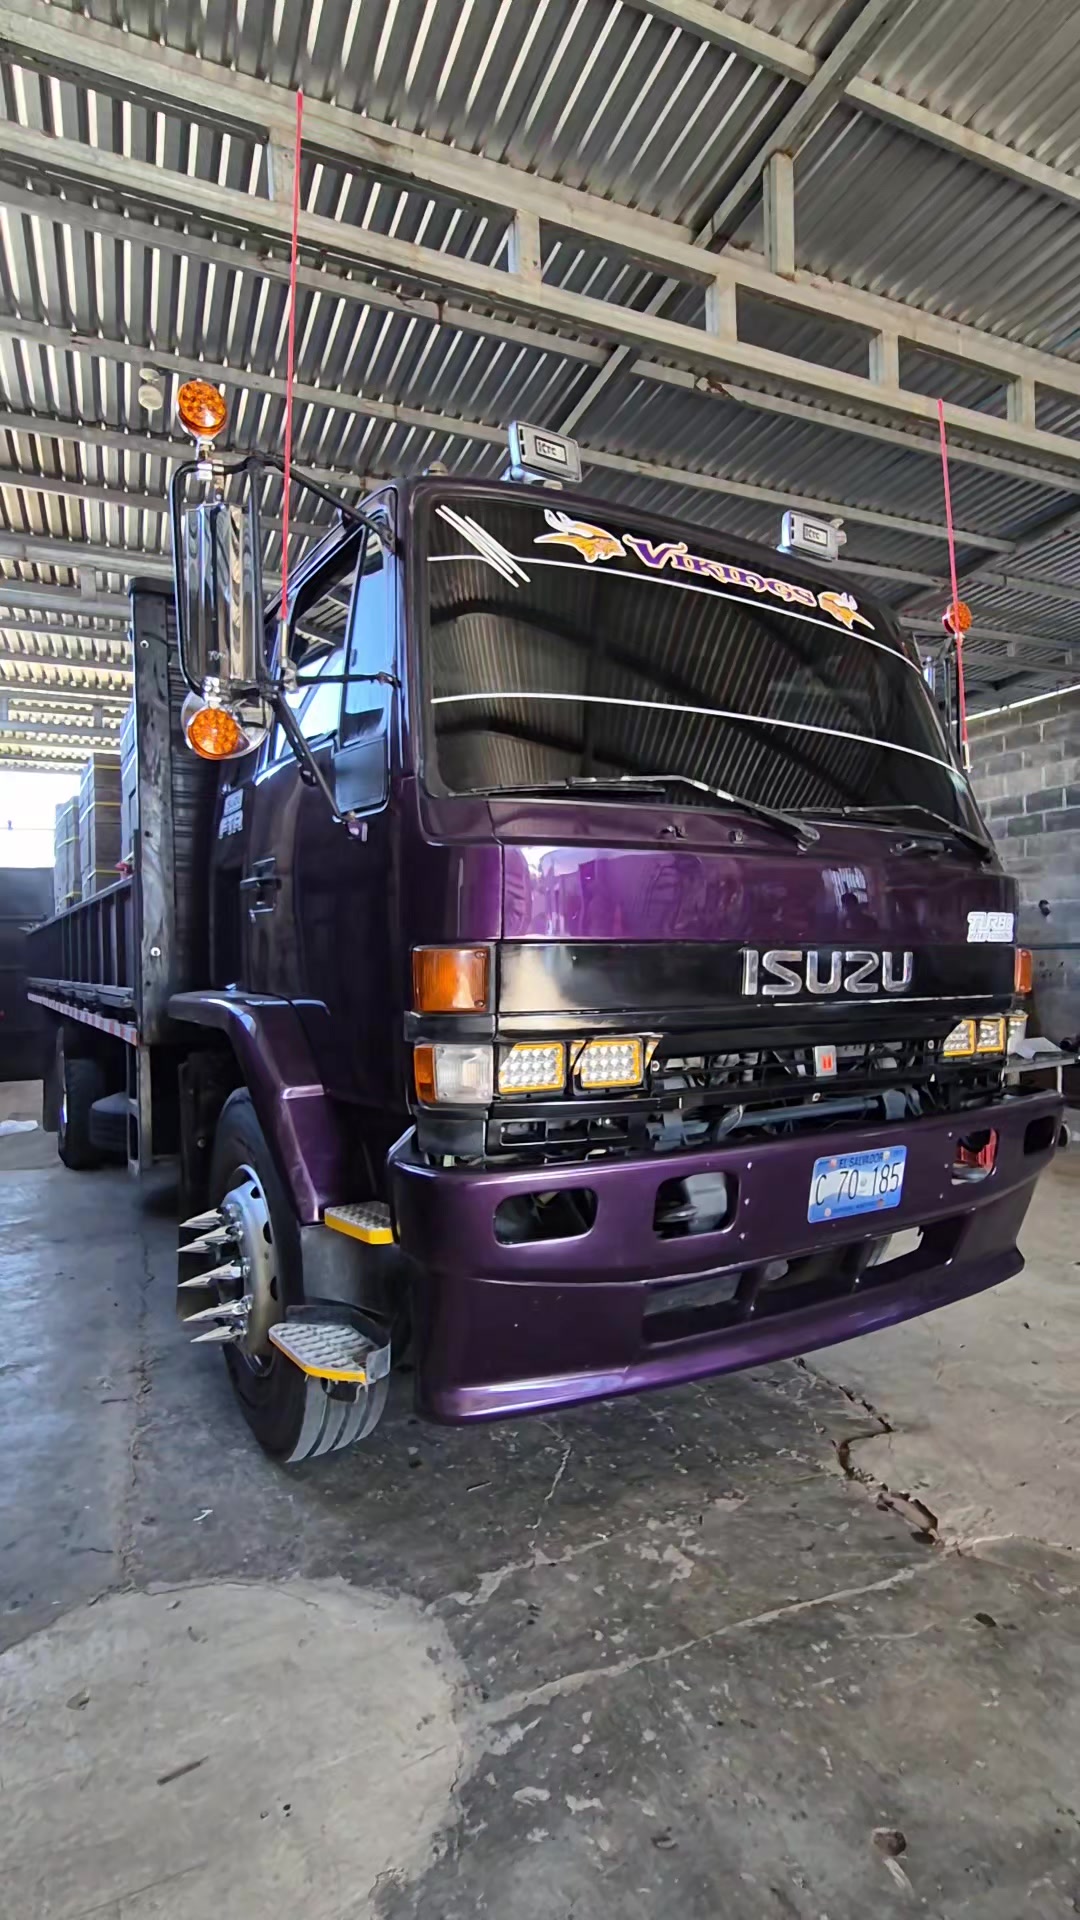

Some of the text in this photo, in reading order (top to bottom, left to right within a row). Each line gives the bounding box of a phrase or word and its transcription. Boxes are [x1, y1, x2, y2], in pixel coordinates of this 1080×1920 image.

[742, 949, 914, 996] ISUZU
[816, 1162, 902, 1206] C 70 185
